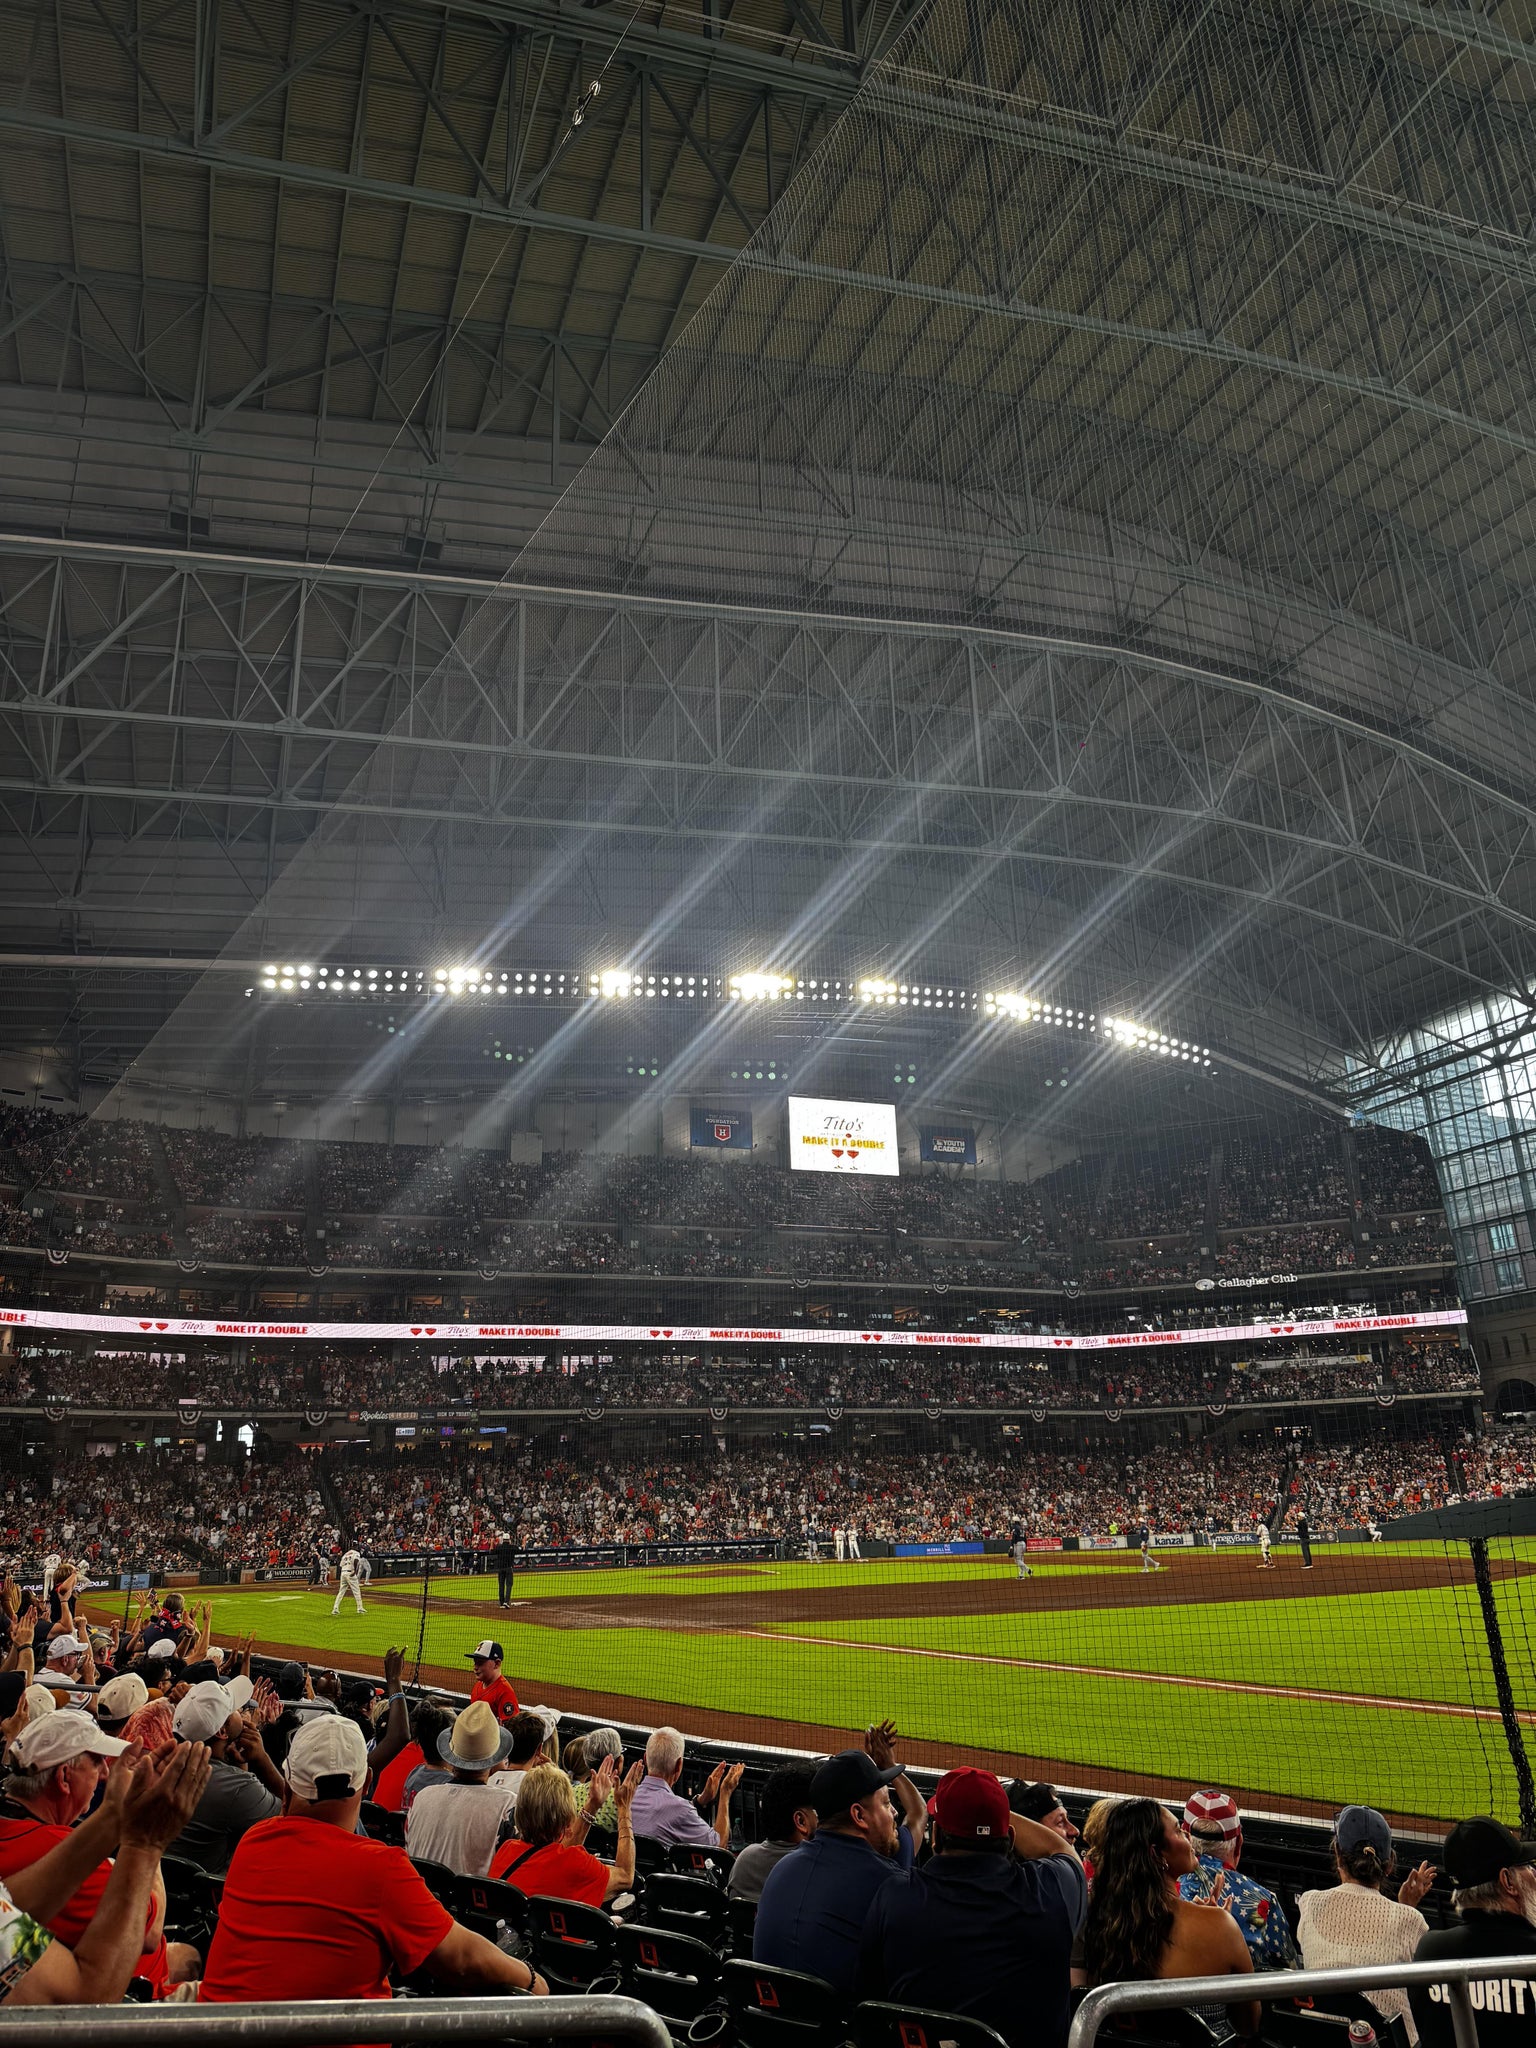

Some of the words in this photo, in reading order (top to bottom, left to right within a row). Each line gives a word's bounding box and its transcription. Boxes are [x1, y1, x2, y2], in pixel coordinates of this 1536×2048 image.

[823, 1116, 864, 1131] Tito's
[802, 1135, 828, 1146] MAKE
[831, 1137, 839, 1146] IT
[842, 1138, 848, 1147] A
[850, 1138, 885, 1149] DOUBLE
[933, 1144, 966, 1154] ACADEMY
[1218, 1276, 1269, 1288] Gallagher
[1270, 1273, 1298, 1284] Club
[1335, 1321, 1362, 1330] MAKE
[1362, 1320, 1371, 1328] IT
[1373, 1319, 1380, 1327] A
[1380, 1317, 1417, 1326] DOUBLE
[216, 1324, 246, 1333] MAKE
[247, 1325, 258, 1334] IT
[258, 1326, 266, 1334] A
[267, 1326, 308, 1335] DOUBLE
[479, 1327, 506, 1335] MAKE
[508, 1328, 517, 1336] IT
[517, 1328, 525, 1336] A
[525, 1328, 561, 1336] DOUBLE
[709, 1330, 735, 1338] MAKE
[744, 1331, 750, 1339] A
[751, 1331, 782, 1340] DOUBLE
[916, 1335, 938, 1343] MAKE
[952, 1336, 982, 1344] DOUBLE
[1141, 1335, 1148, 1343] A
[1149, 1333, 1181, 1342] DOUBLE
[1154, 1536, 1184, 1546] kanzal
[1428, 1979, 1536, 2015] SURIT
